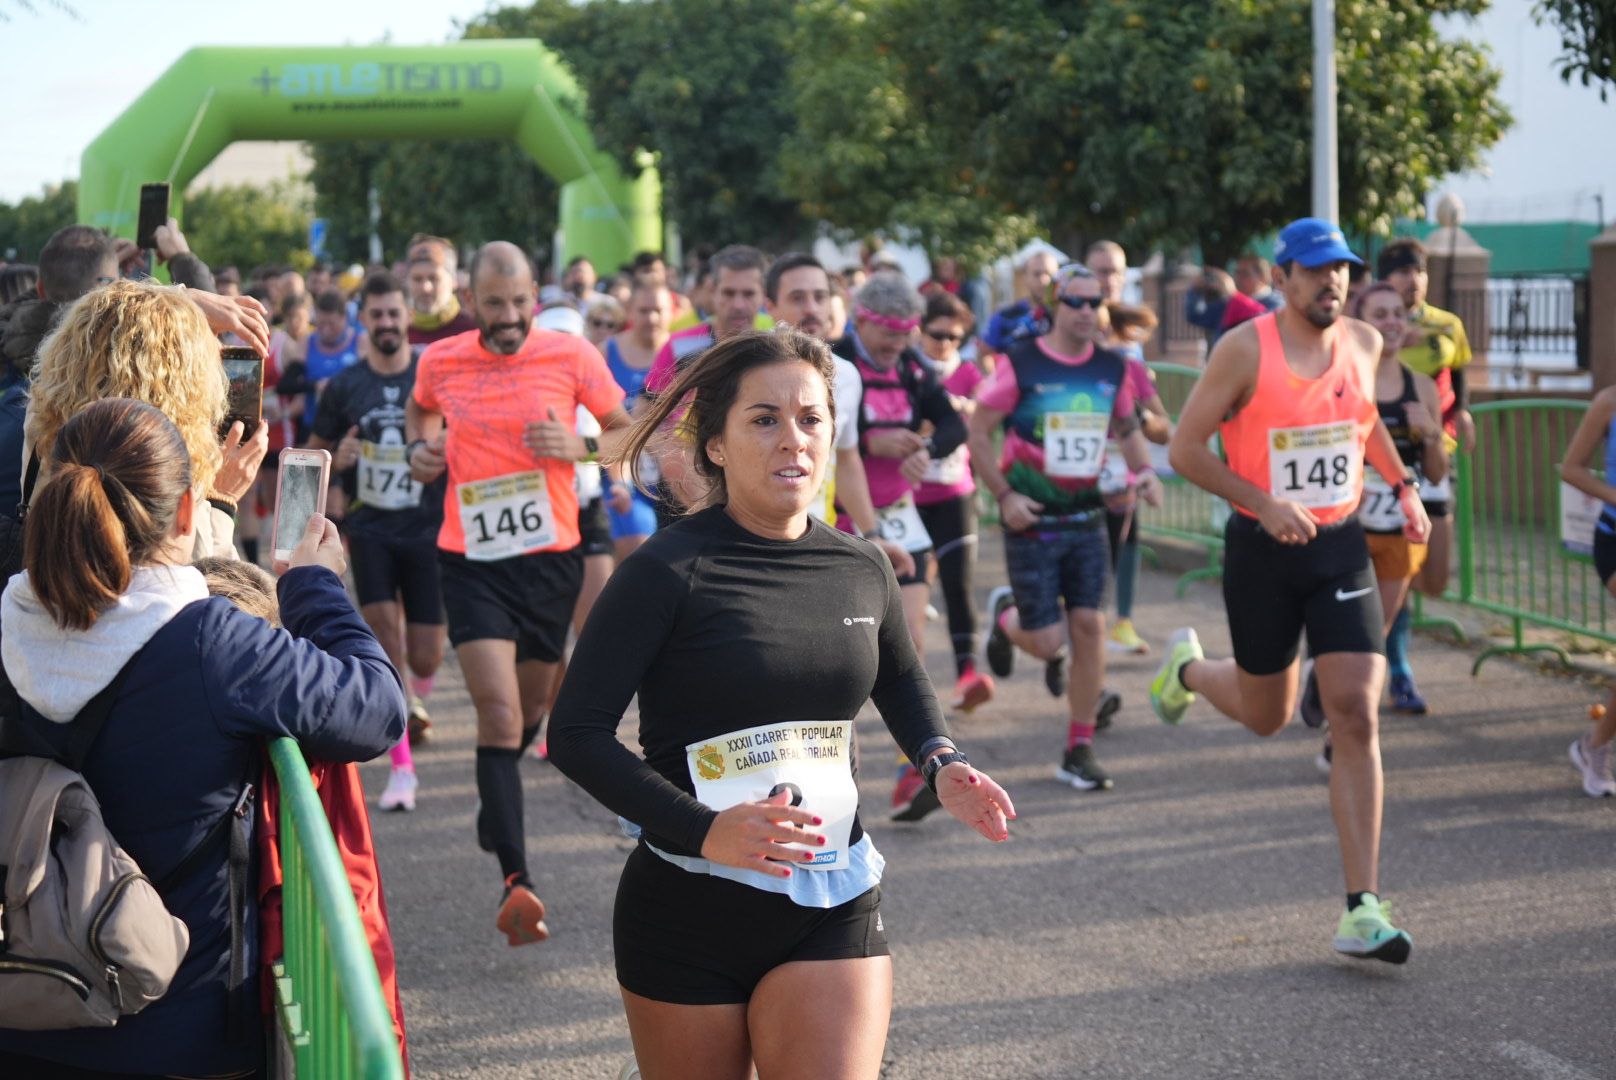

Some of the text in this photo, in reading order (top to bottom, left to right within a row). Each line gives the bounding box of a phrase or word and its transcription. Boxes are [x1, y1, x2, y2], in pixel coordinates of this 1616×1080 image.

[1057, 436, 1100, 461] 157
[365, 467, 413, 493] 174
[1283, 454, 1348, 491] 148
[472, 500, 542, 543] 146
[726, 735, 753, 753] XXXII
[801, 726, 843, 741] POPULAR
[735, 750, 778, 771] CAÑADA
